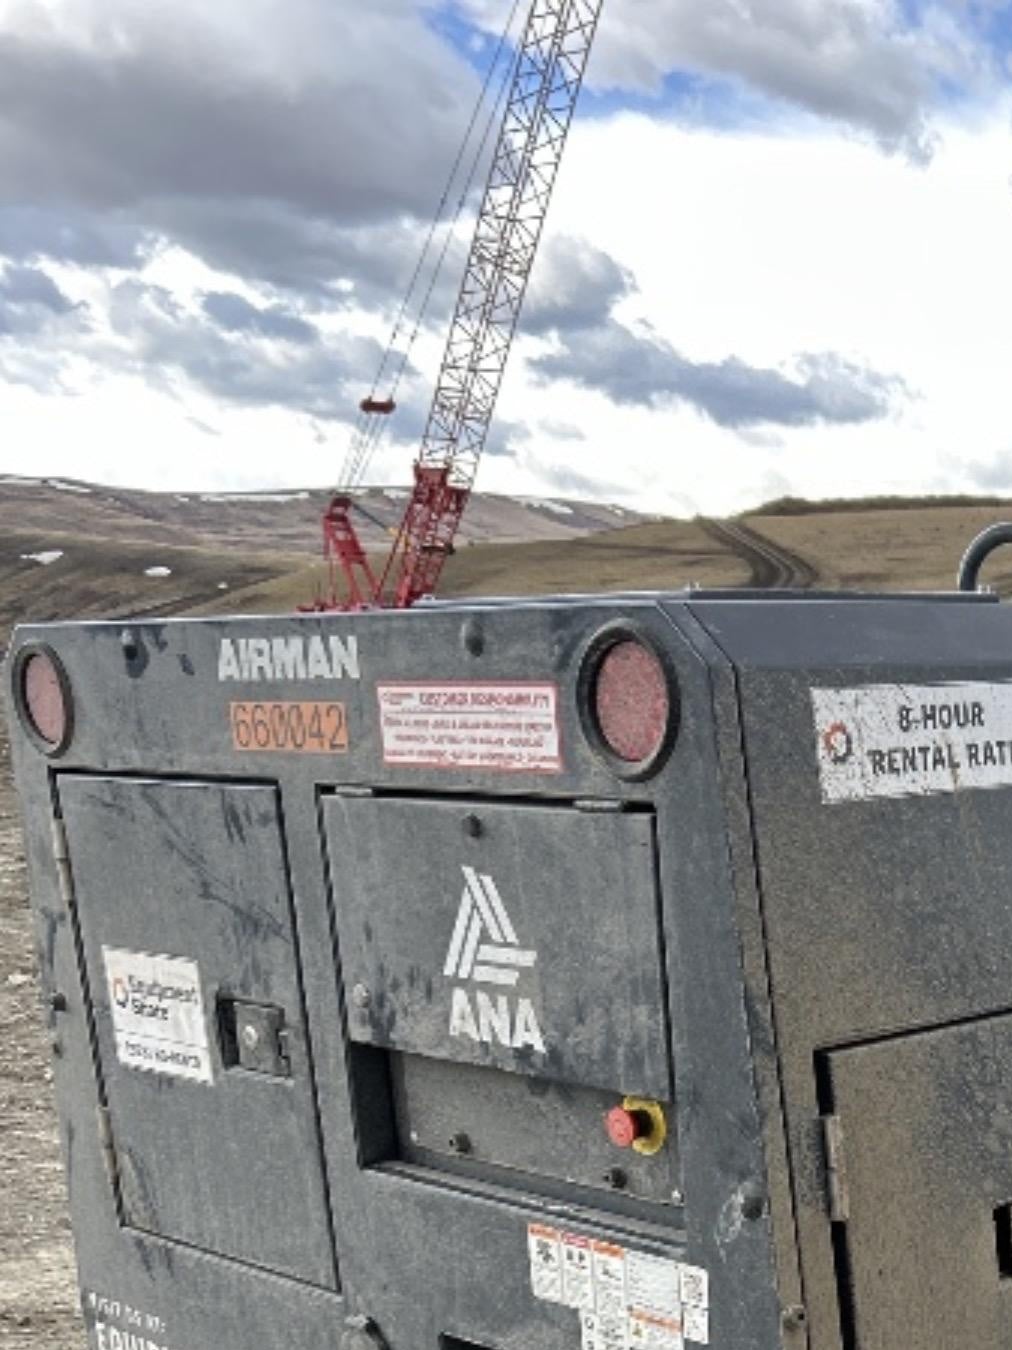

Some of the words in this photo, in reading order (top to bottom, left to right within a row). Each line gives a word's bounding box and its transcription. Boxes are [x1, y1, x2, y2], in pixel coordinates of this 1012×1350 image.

[218, 634, 361, 682] AIRMAN
[233, 703, 346, 750] 660042
[899, 701, 985, 732] 8-HOUR
[868, 743, 961, 776] RENTAL
[449, 986, 547, 1054] ANA
